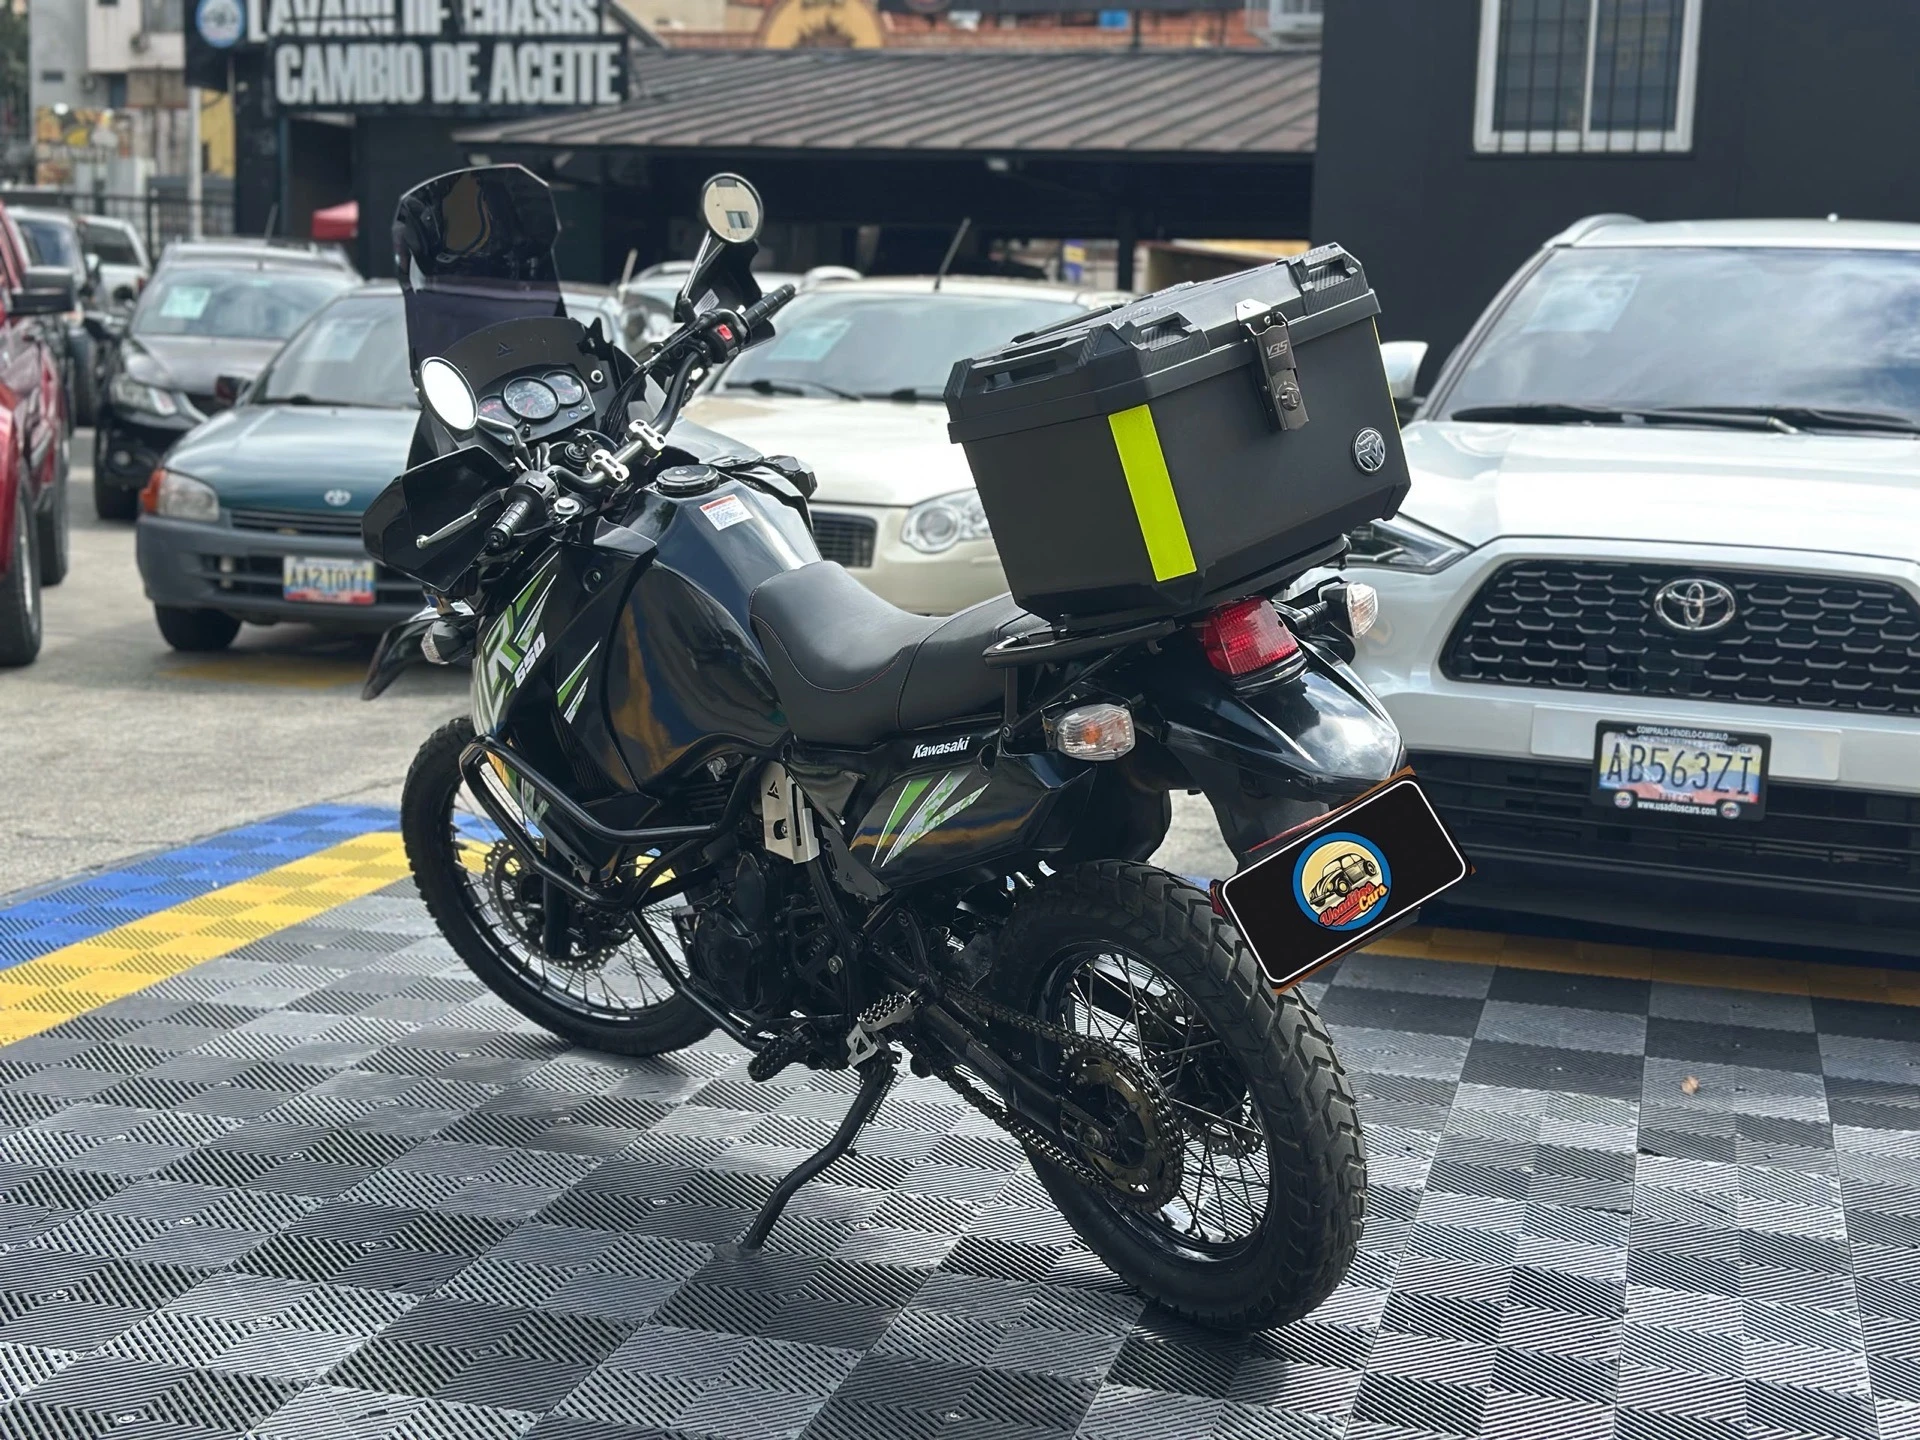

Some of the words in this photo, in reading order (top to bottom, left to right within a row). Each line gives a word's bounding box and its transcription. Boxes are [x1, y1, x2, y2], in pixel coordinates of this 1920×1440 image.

[274, 43, 424, 105] CAMBIO
[429, 43, 480, 104] DE
[489, 43, 621, 105] ACEITE
[513, 631, 547, 688] 650
[911, 736, 971, 759] Kawasaki
[1606, 742, 1753, 796] AB563ZI
[1637, 801, 1718, 817] www.usaditoscars.com
